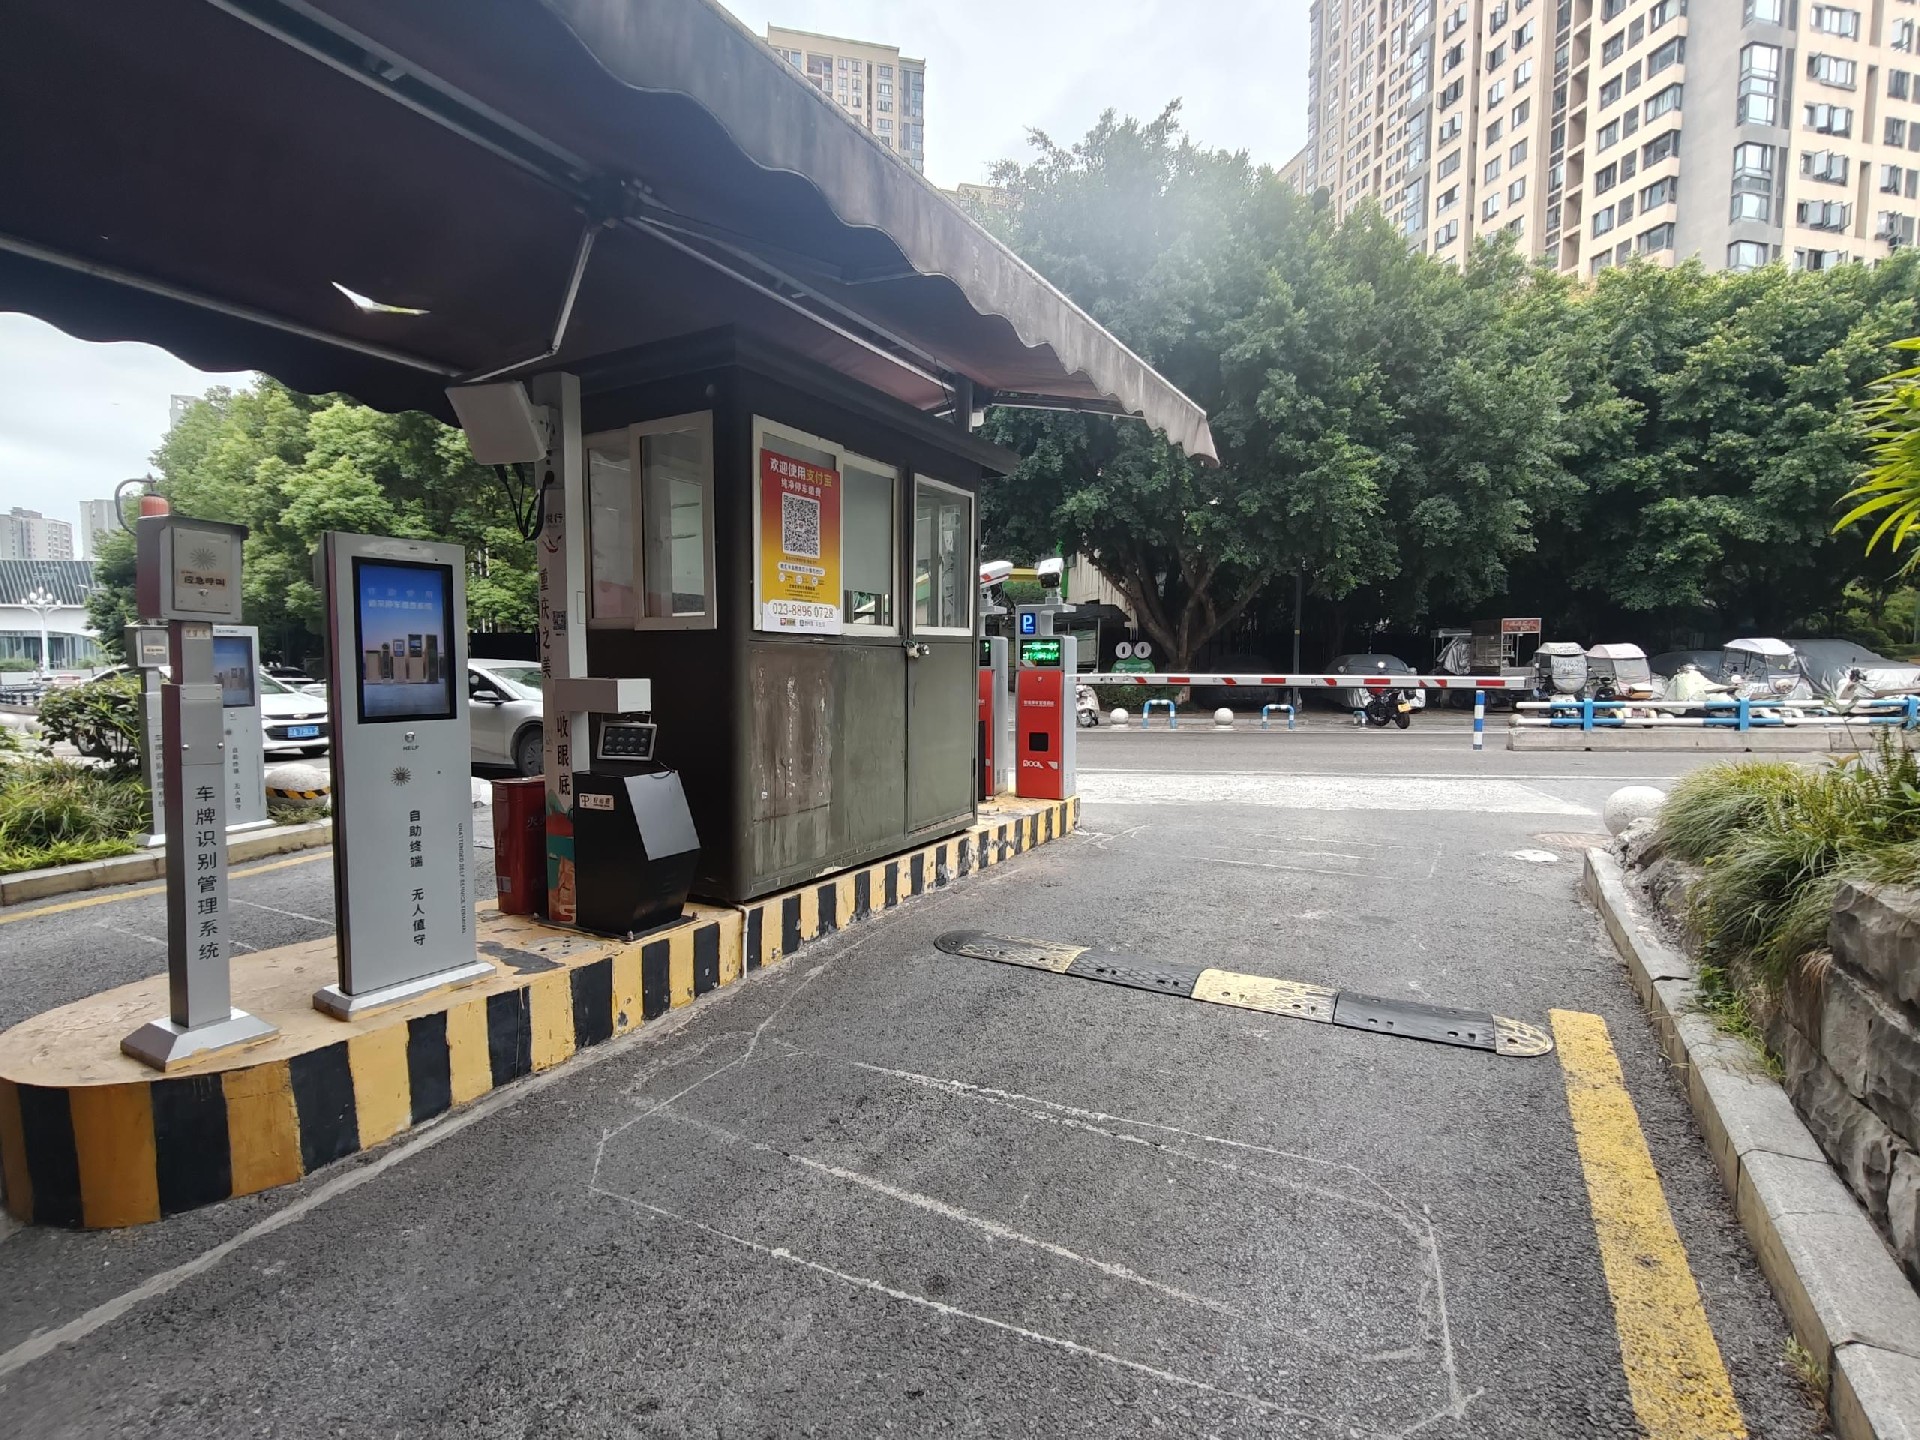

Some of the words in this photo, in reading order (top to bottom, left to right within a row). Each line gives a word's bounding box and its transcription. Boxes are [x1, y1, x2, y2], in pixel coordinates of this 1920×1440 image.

[769, 457, 832, 487] 欢迎使用支付宝
[184, 575, 225, 587] 应急呼叫
[539, 567, 551, 679] 重庆之美
[772, 602, 812, 617] 023-8896
[814, 606, 834, 619] 0728
[1022, 614, 1033, 632] P
[556, 710, 571, 796] 收眼底
[409, 809, 423, 868] 自助终端
[457, 822, 465, 863] UNATTENDED
[194, 785, 220, 961] 车牌识别管理系统
[411, 887, 426, 946] 无人值守
